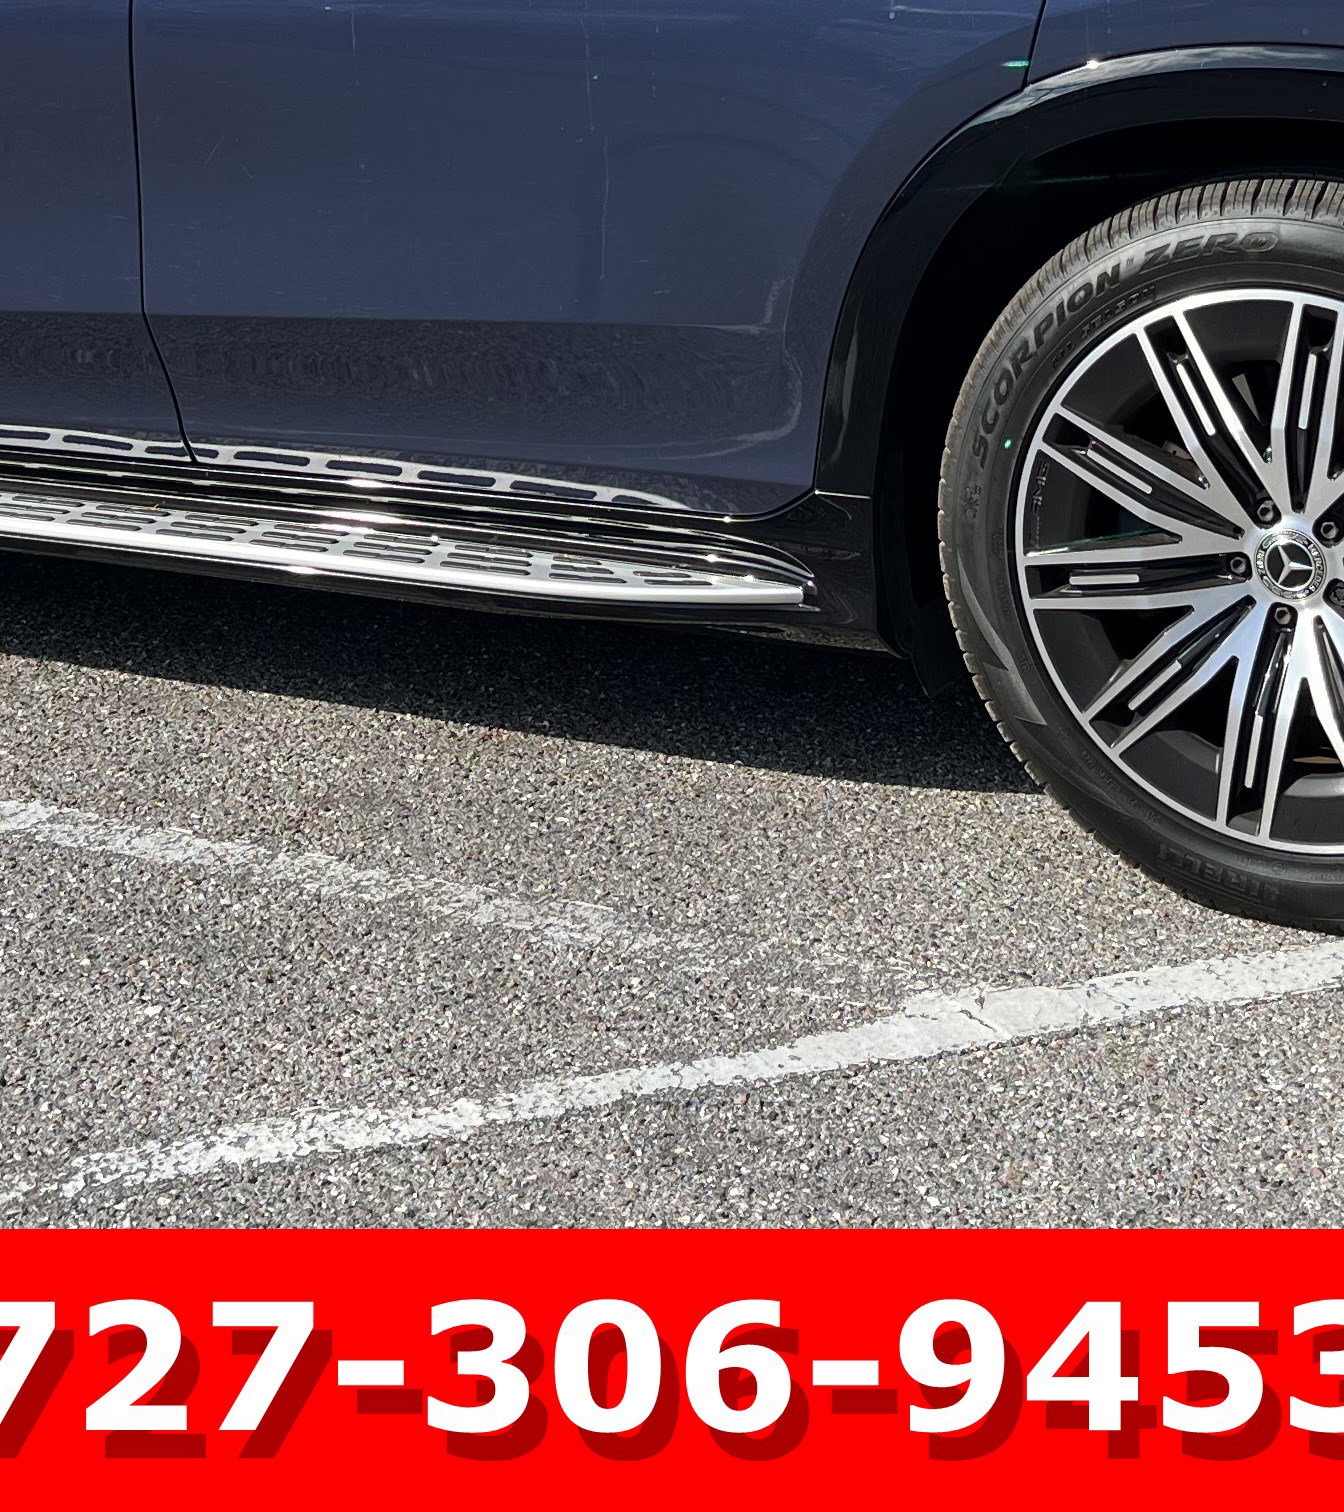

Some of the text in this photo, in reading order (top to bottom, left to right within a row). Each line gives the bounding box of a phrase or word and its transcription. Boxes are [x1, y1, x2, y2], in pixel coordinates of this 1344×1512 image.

[972, 230, 1280, 469] SCORPION ZERO
[1156, 843, 1281, 909] PIRELLI
